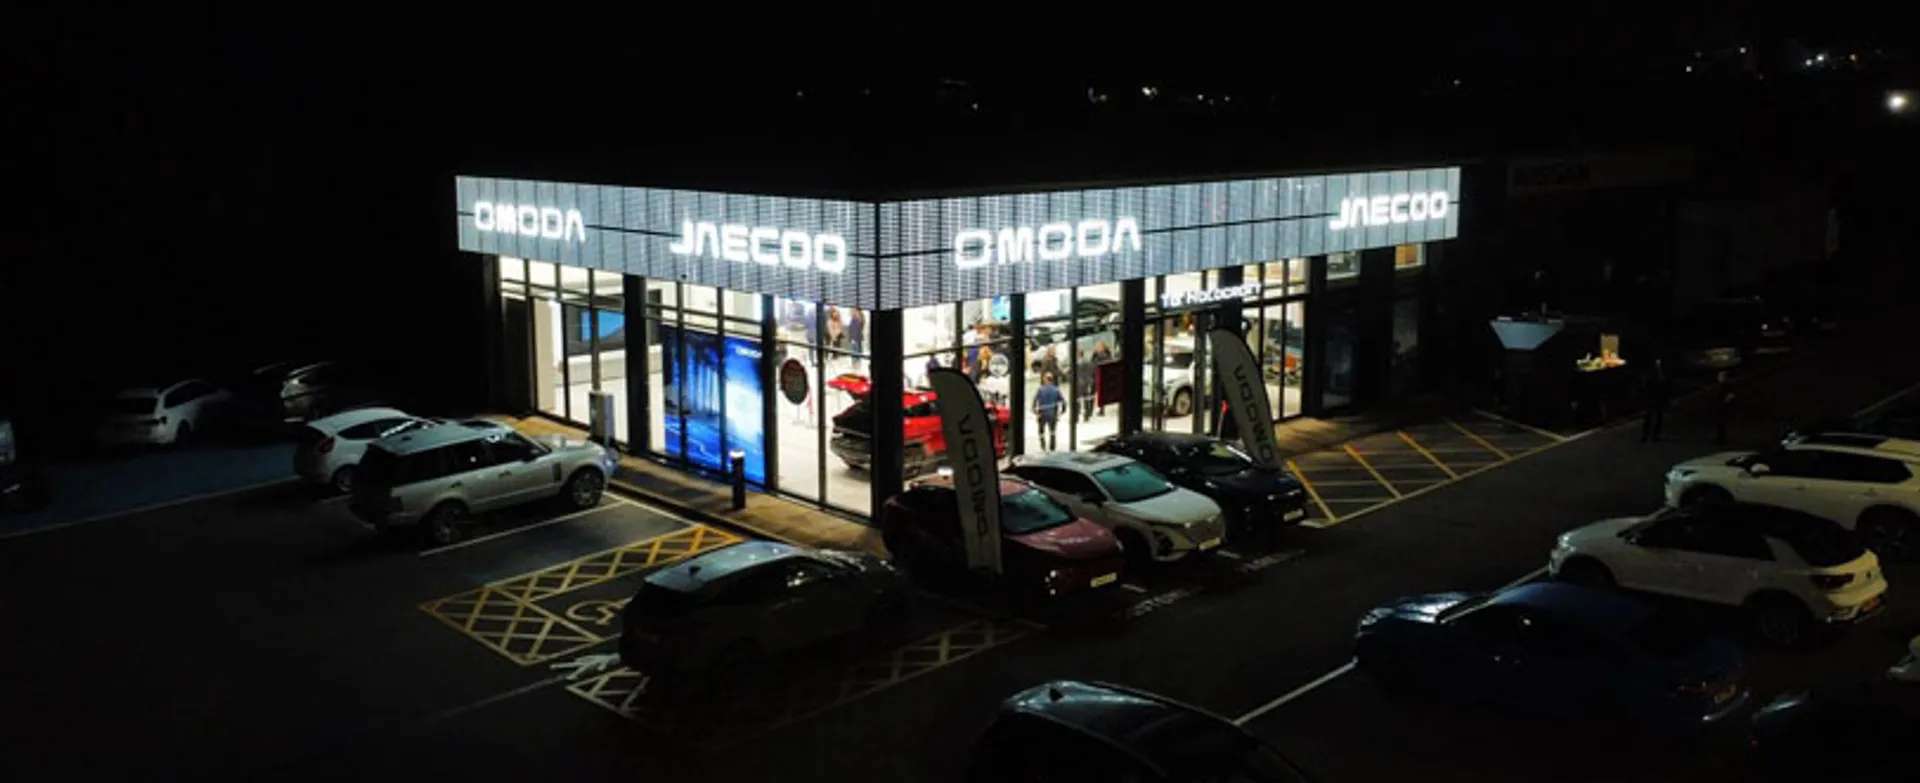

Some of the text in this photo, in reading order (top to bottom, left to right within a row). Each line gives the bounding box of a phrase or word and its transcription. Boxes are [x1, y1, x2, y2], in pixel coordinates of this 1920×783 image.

[474, 201, 586, 243] OMODA
[1329, 190, 1448, 230] JAECOO
[670, 220, 847, 273] JAECOO
[954, 216, 1141, 269] OMODA
